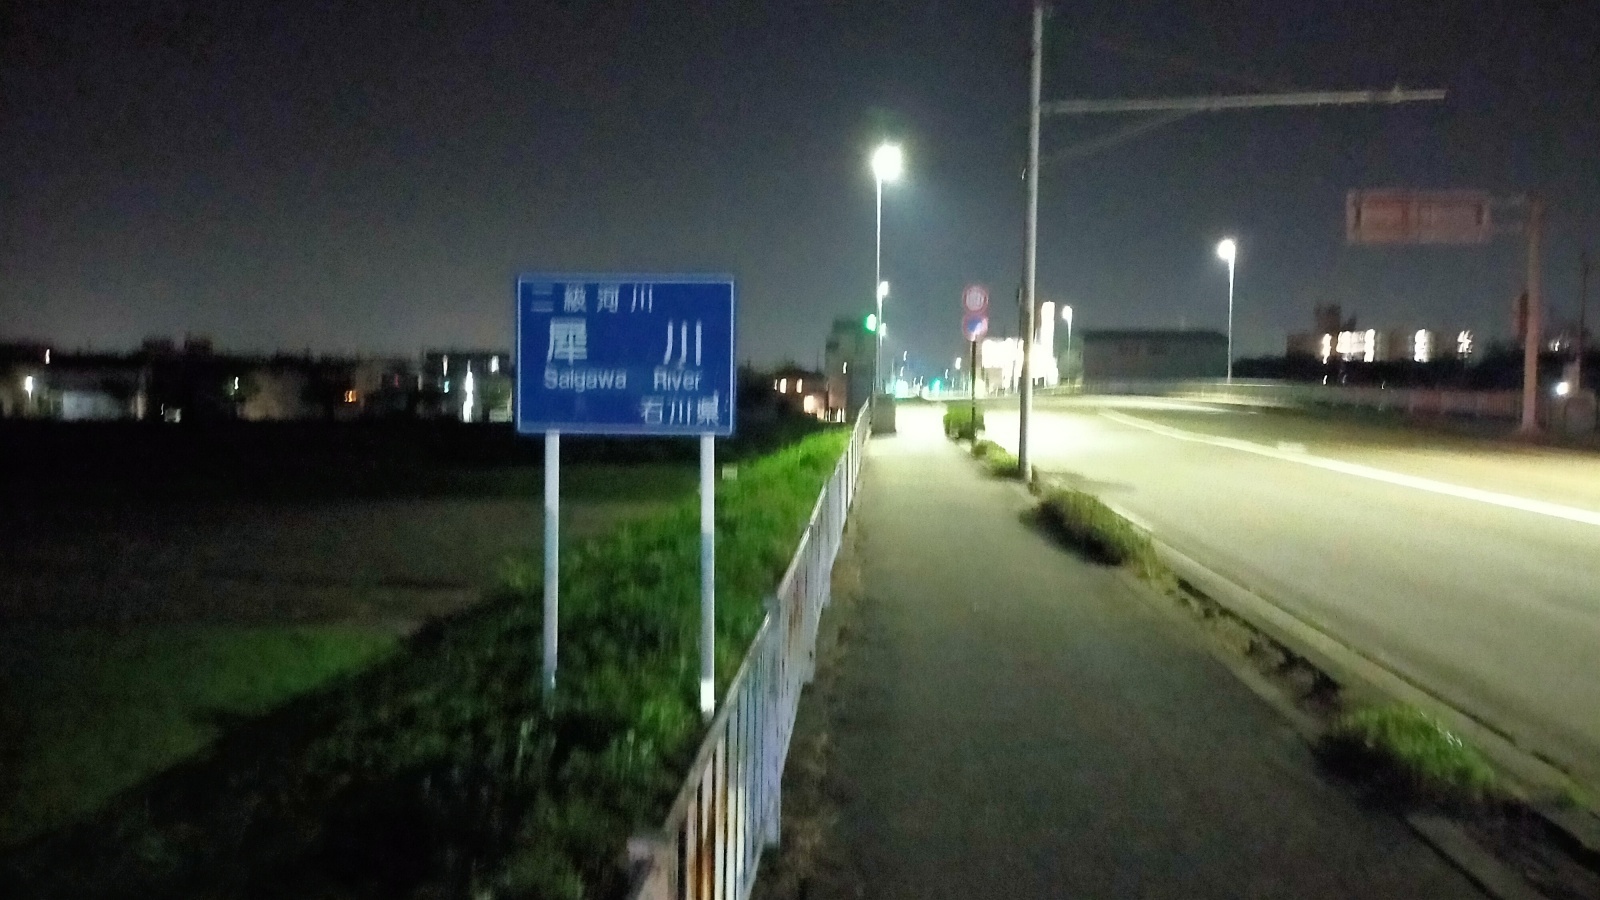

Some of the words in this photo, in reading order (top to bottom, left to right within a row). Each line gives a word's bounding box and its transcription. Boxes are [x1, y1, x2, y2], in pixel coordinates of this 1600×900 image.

[544, 367, 628, 392] Saigawa
[654, 367, 702, 391] River
[641, 393, 719, 426] 石川県
